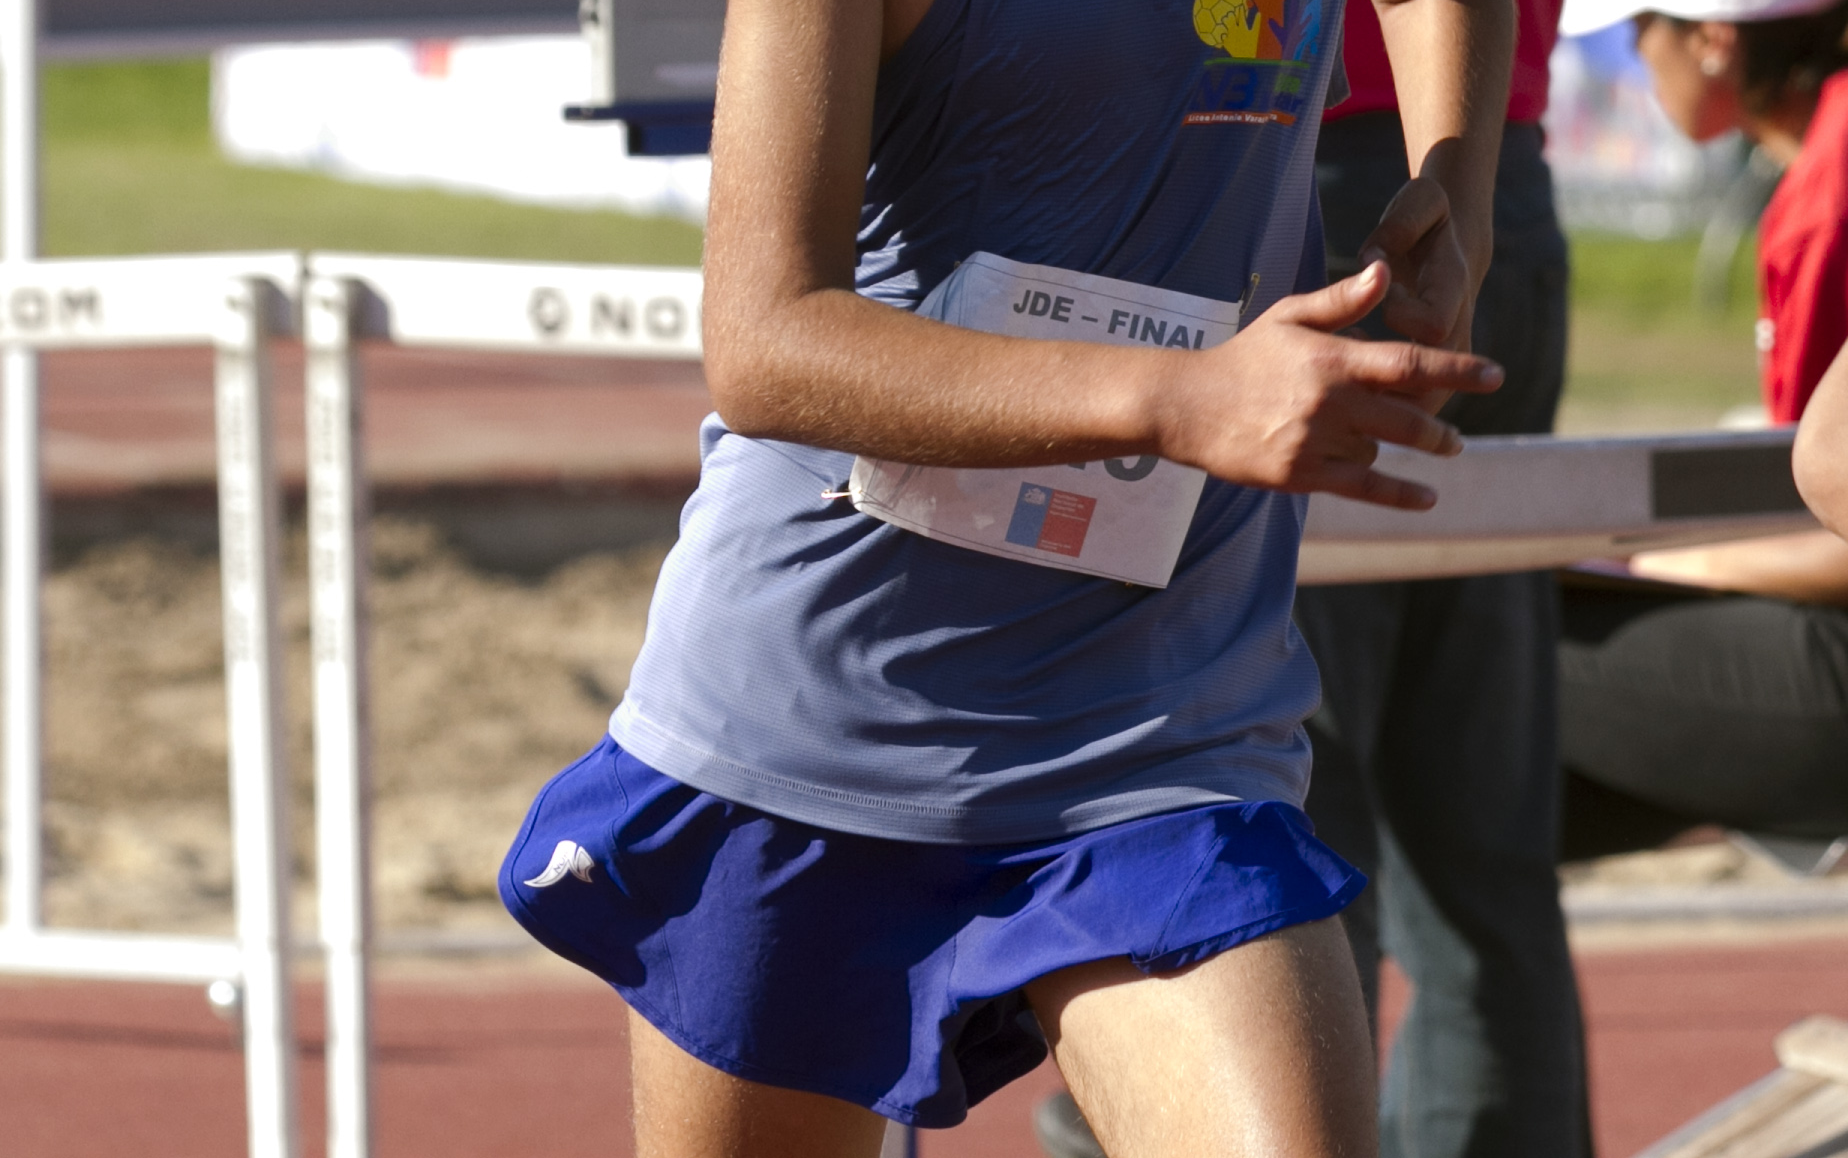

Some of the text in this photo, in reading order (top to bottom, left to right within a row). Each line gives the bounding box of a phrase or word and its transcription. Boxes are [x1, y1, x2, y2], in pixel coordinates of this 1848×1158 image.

[1211, 113, 1242, 122] Antonio
[0, 285, 104, 332] OM
[1013, 289, 1075, 323] JDE
